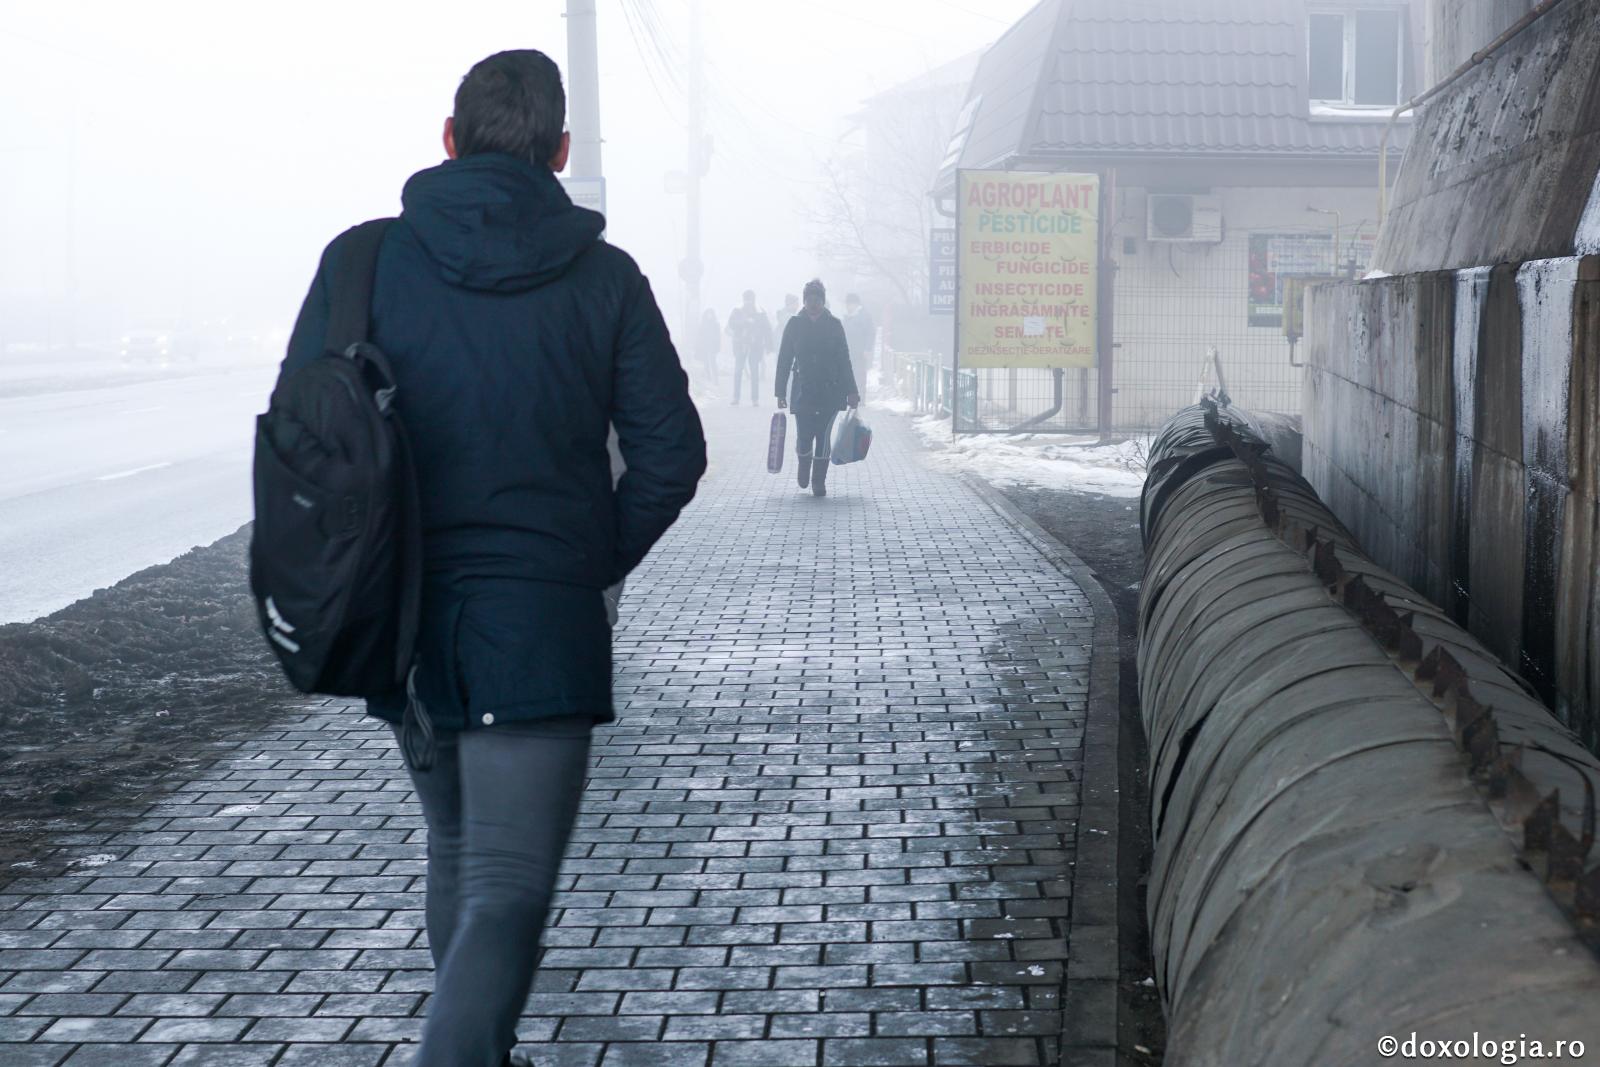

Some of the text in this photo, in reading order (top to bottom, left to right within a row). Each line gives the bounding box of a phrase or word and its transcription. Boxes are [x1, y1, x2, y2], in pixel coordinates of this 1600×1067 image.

[968, 182, 1093, 209] AGROPLANT
[978, 214, 1082, 234] PESTICIDE
[970, 240, 1052, 255] ERBICIDE
[996, 261, 1089, 275] FUNGICIDE
[975, 283, 1084, 296] INSECTICIDE
